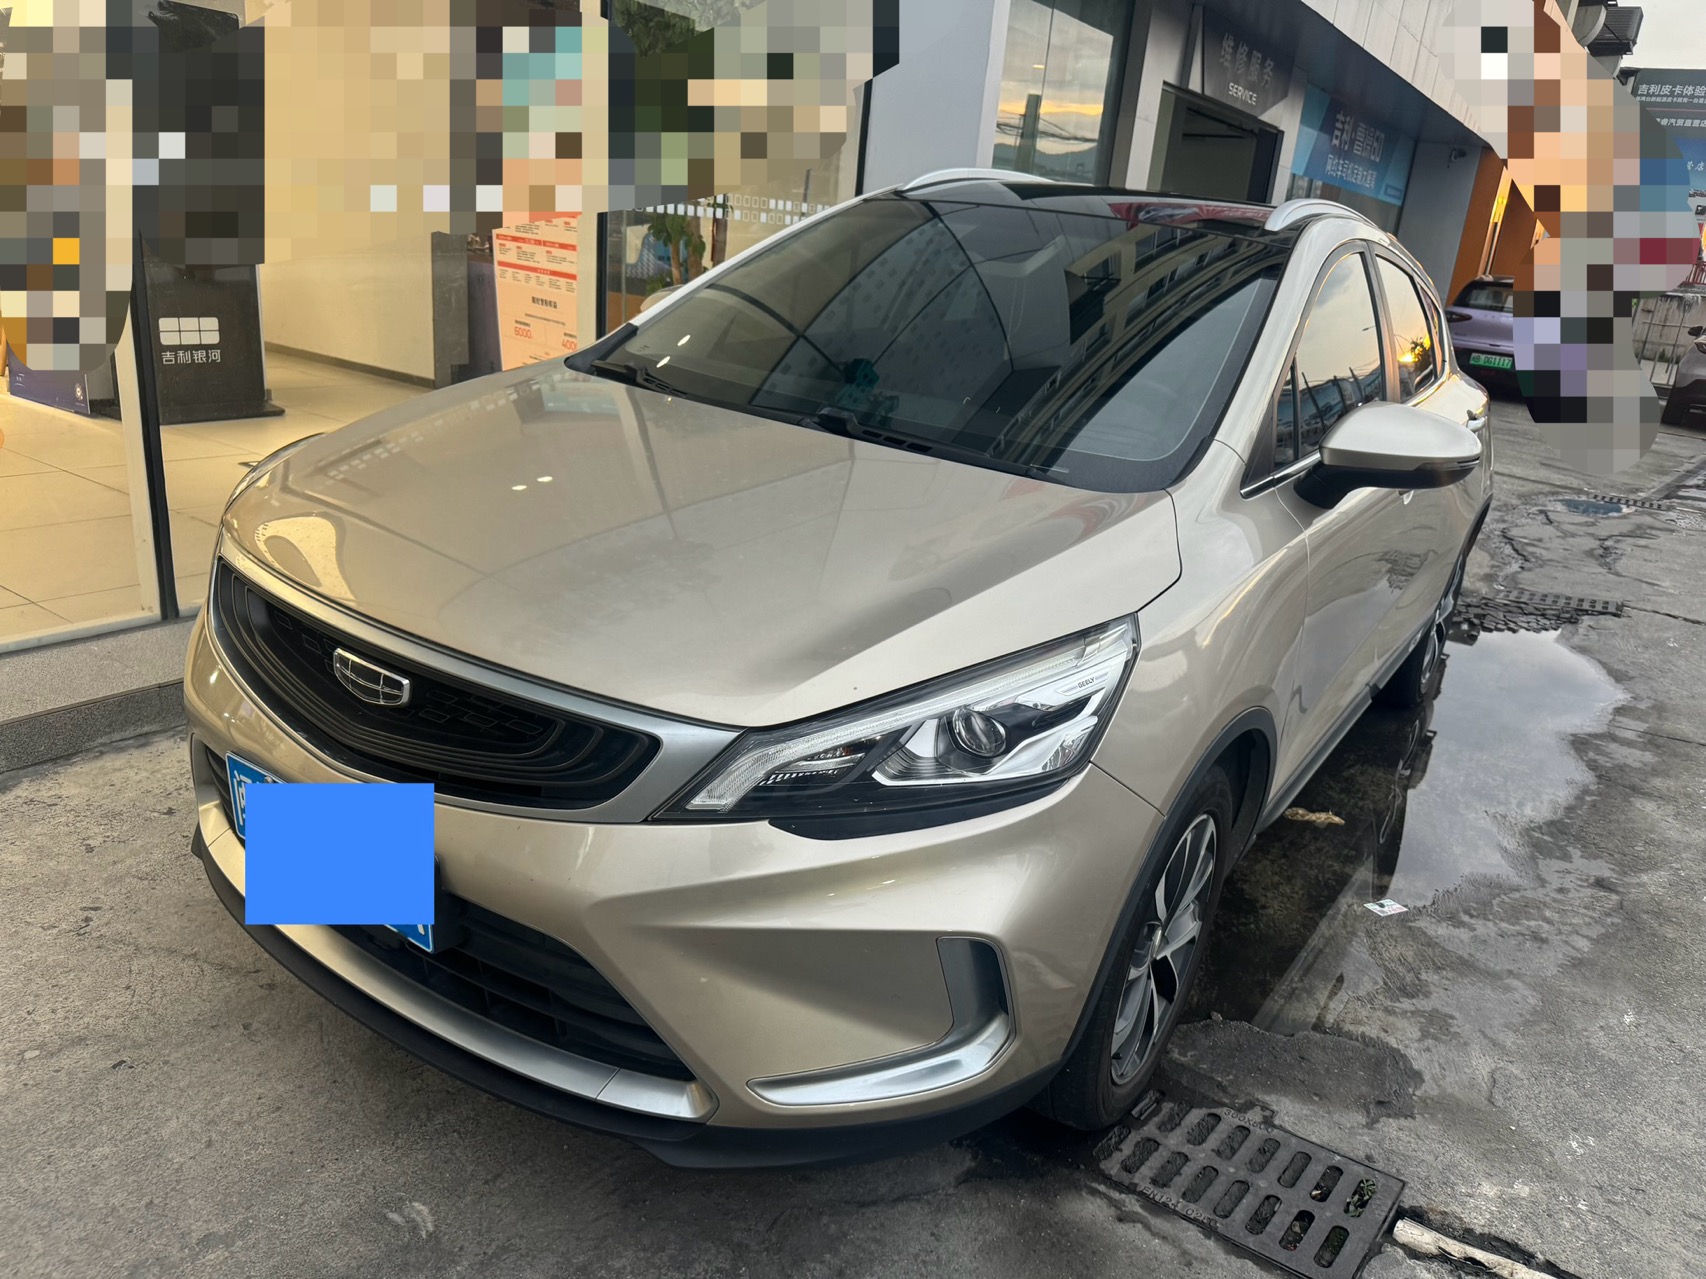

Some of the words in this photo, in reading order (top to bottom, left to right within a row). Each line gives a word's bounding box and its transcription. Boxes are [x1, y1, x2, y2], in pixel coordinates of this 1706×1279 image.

[1228, 82, 1257, 105] SERVICE
[1638, 84, 1706, 96] 吉利皮卡体验
[161, 350, 221, 364] 吉利银河
[1077, 677, 1095, 688] GEELY
